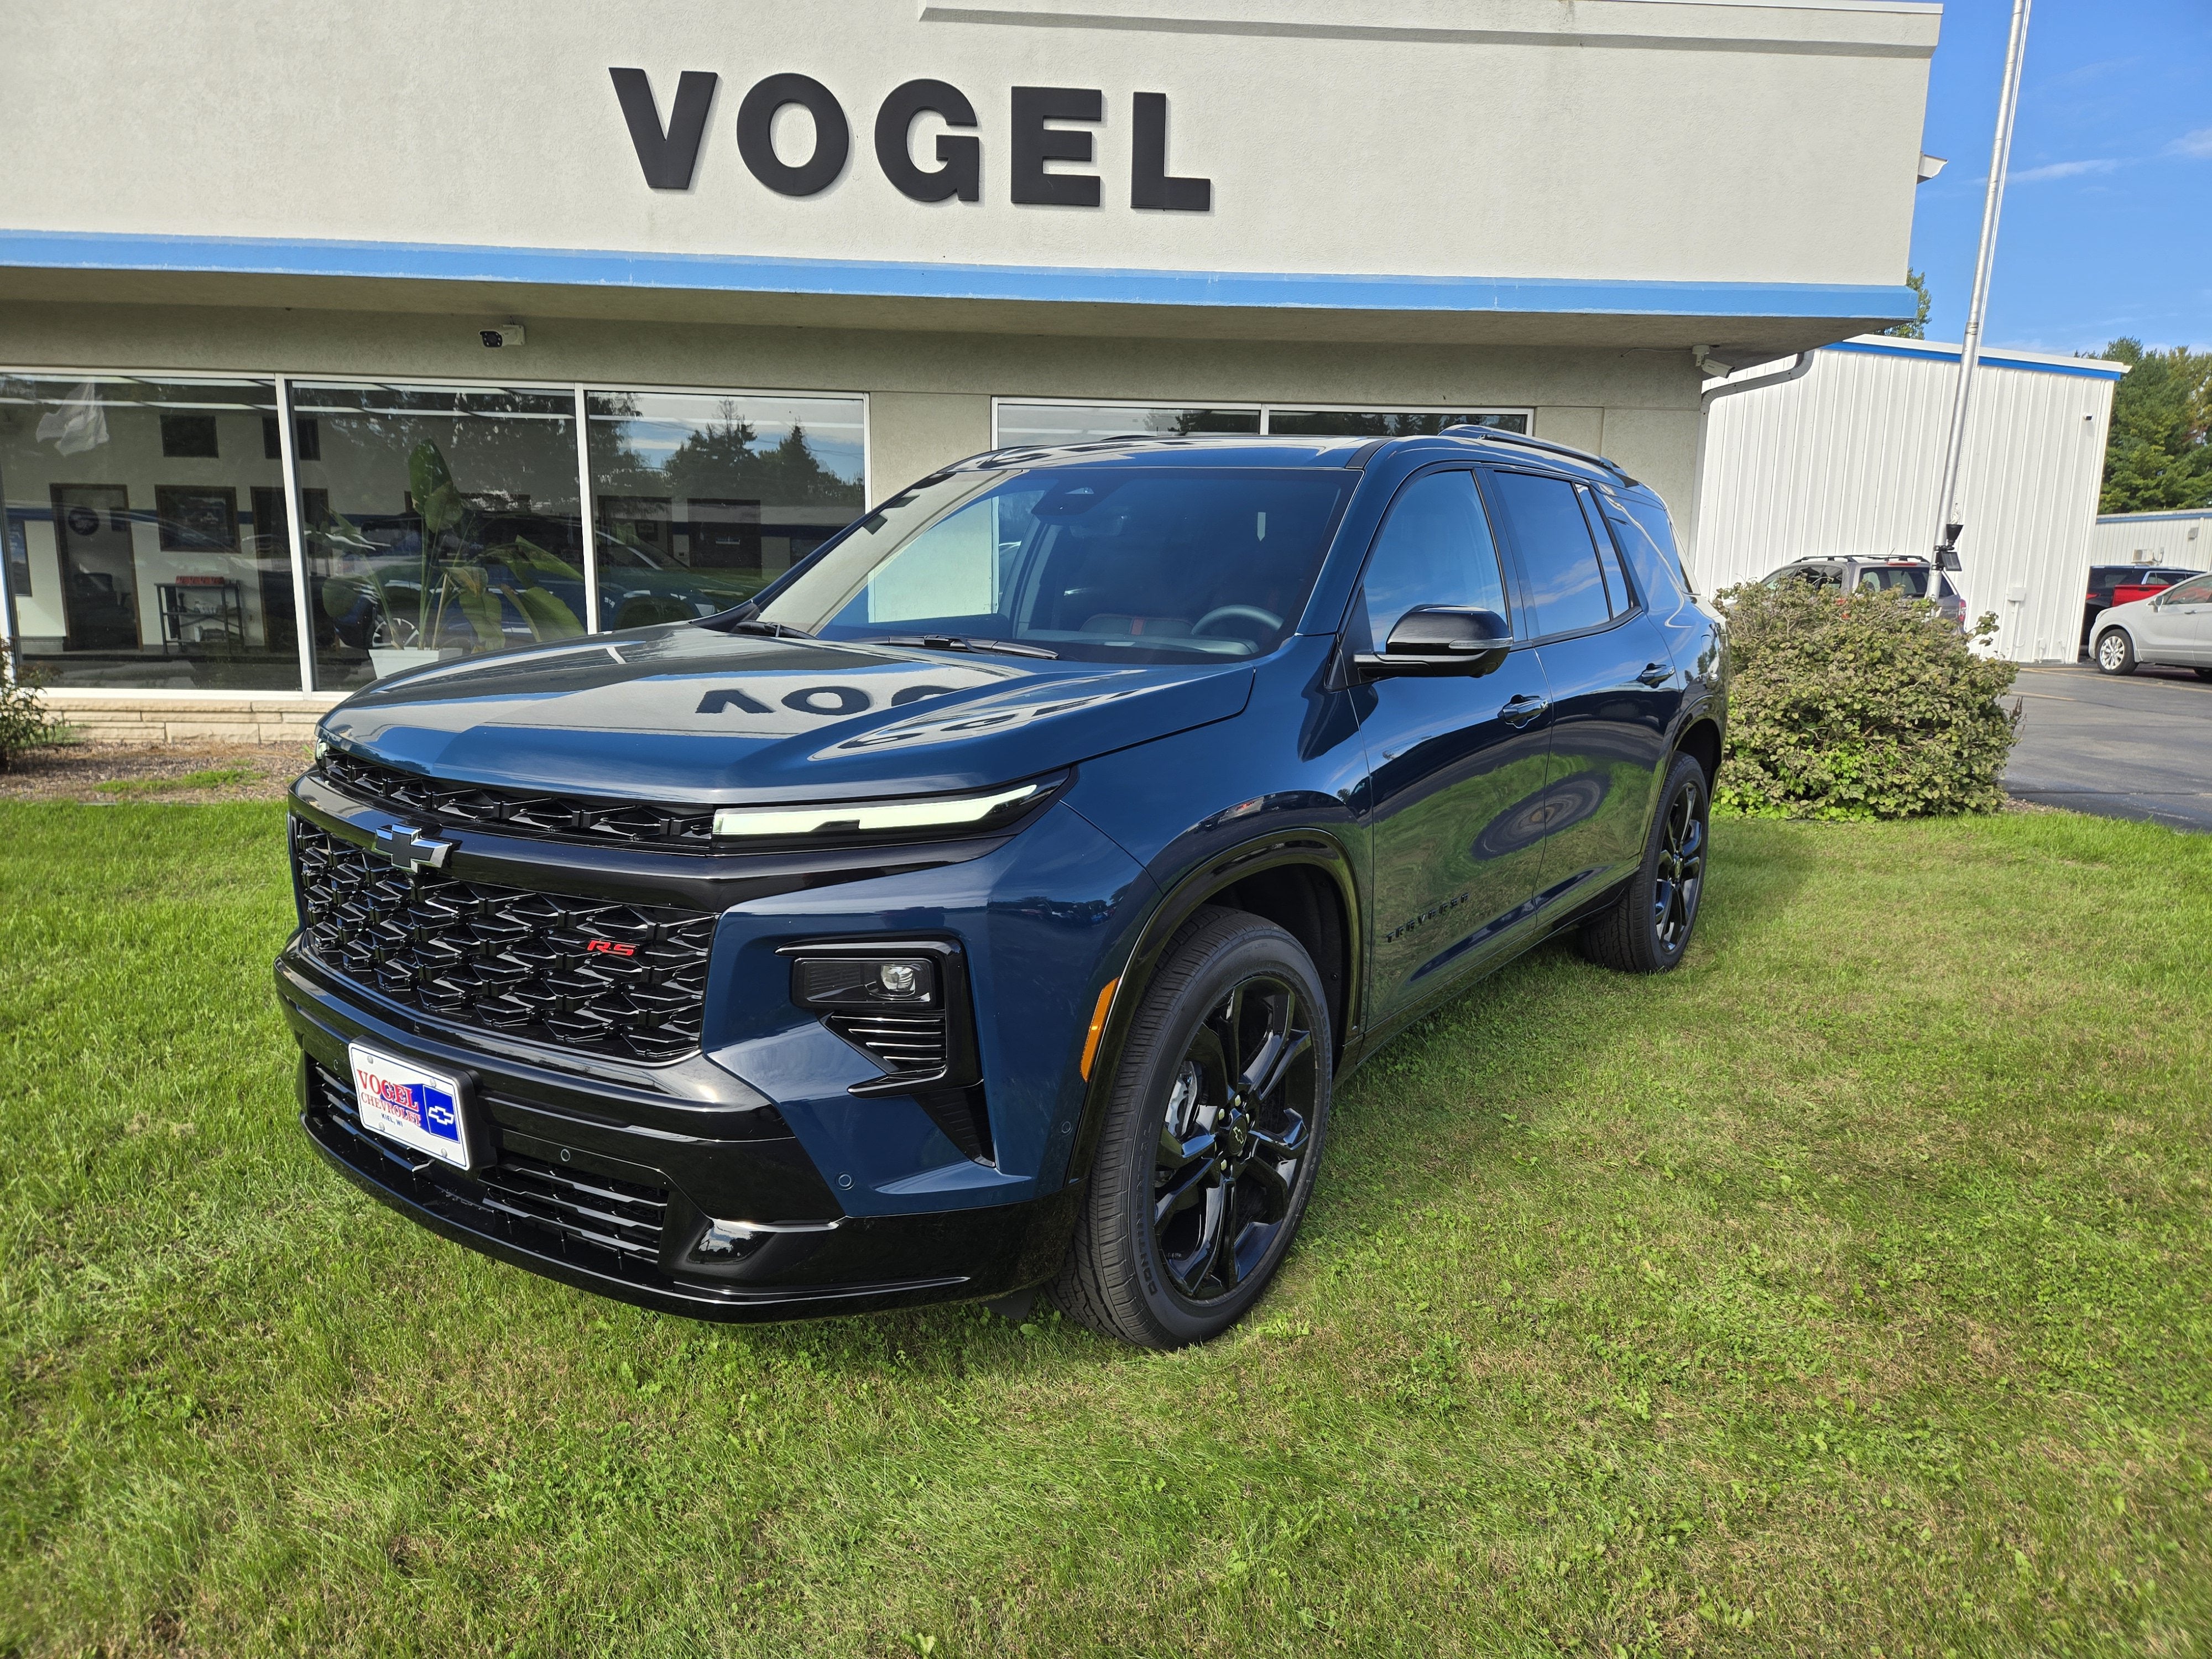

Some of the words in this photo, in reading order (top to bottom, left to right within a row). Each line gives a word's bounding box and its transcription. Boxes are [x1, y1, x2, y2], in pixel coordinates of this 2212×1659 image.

[609, 67, 1211, 211] VOGEL
[1386, 892, 1469, 943] TRAVERSE
[587, 940, 637, 956] RS
[357, 1069, 419, 1112] VOGEL
[361, 1092, 421, 1126] CHEVROLET
[381, 1113, 395, 1124] KIEL,
[1135, 1121, 1158, 1296] CONTINENTAL
